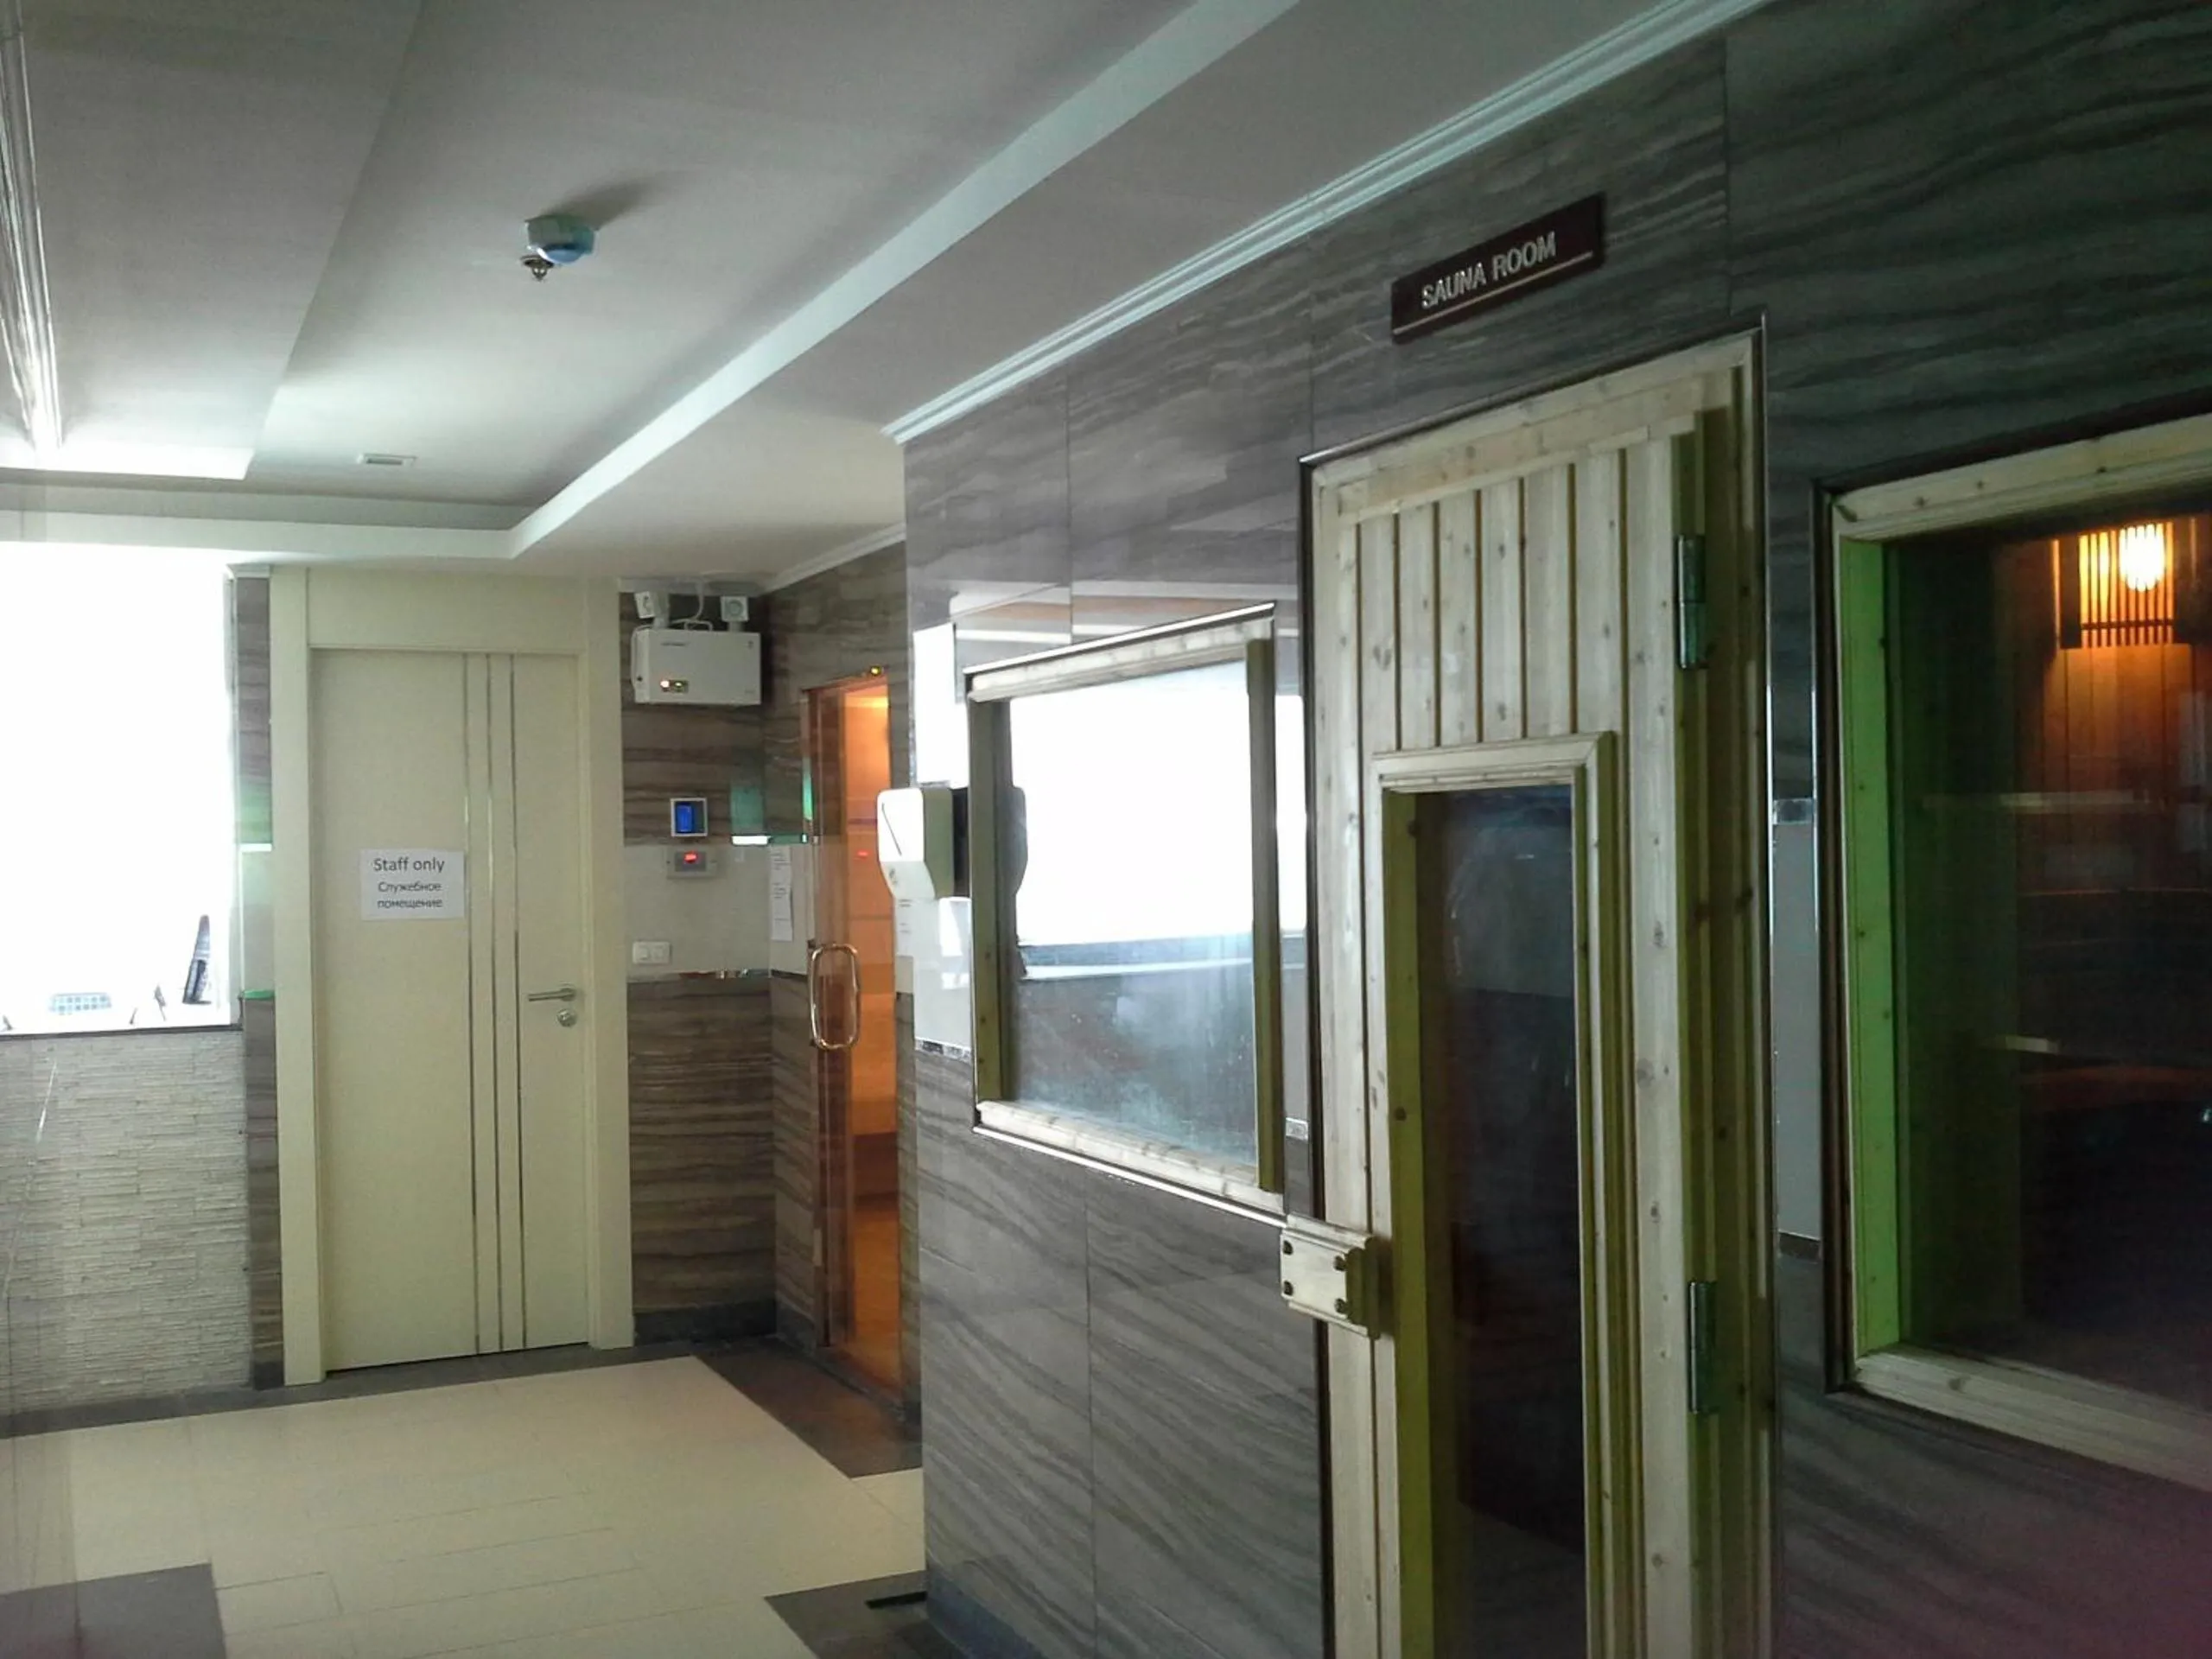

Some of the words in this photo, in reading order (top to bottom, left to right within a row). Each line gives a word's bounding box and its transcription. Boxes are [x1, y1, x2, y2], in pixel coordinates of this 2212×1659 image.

[1421, 262, 1487, 309] SAUNA
[1492, 231, 1557, 281] ROOM
[373, 855, 409, 872] Staff
[412, 856, 445, 873] only
